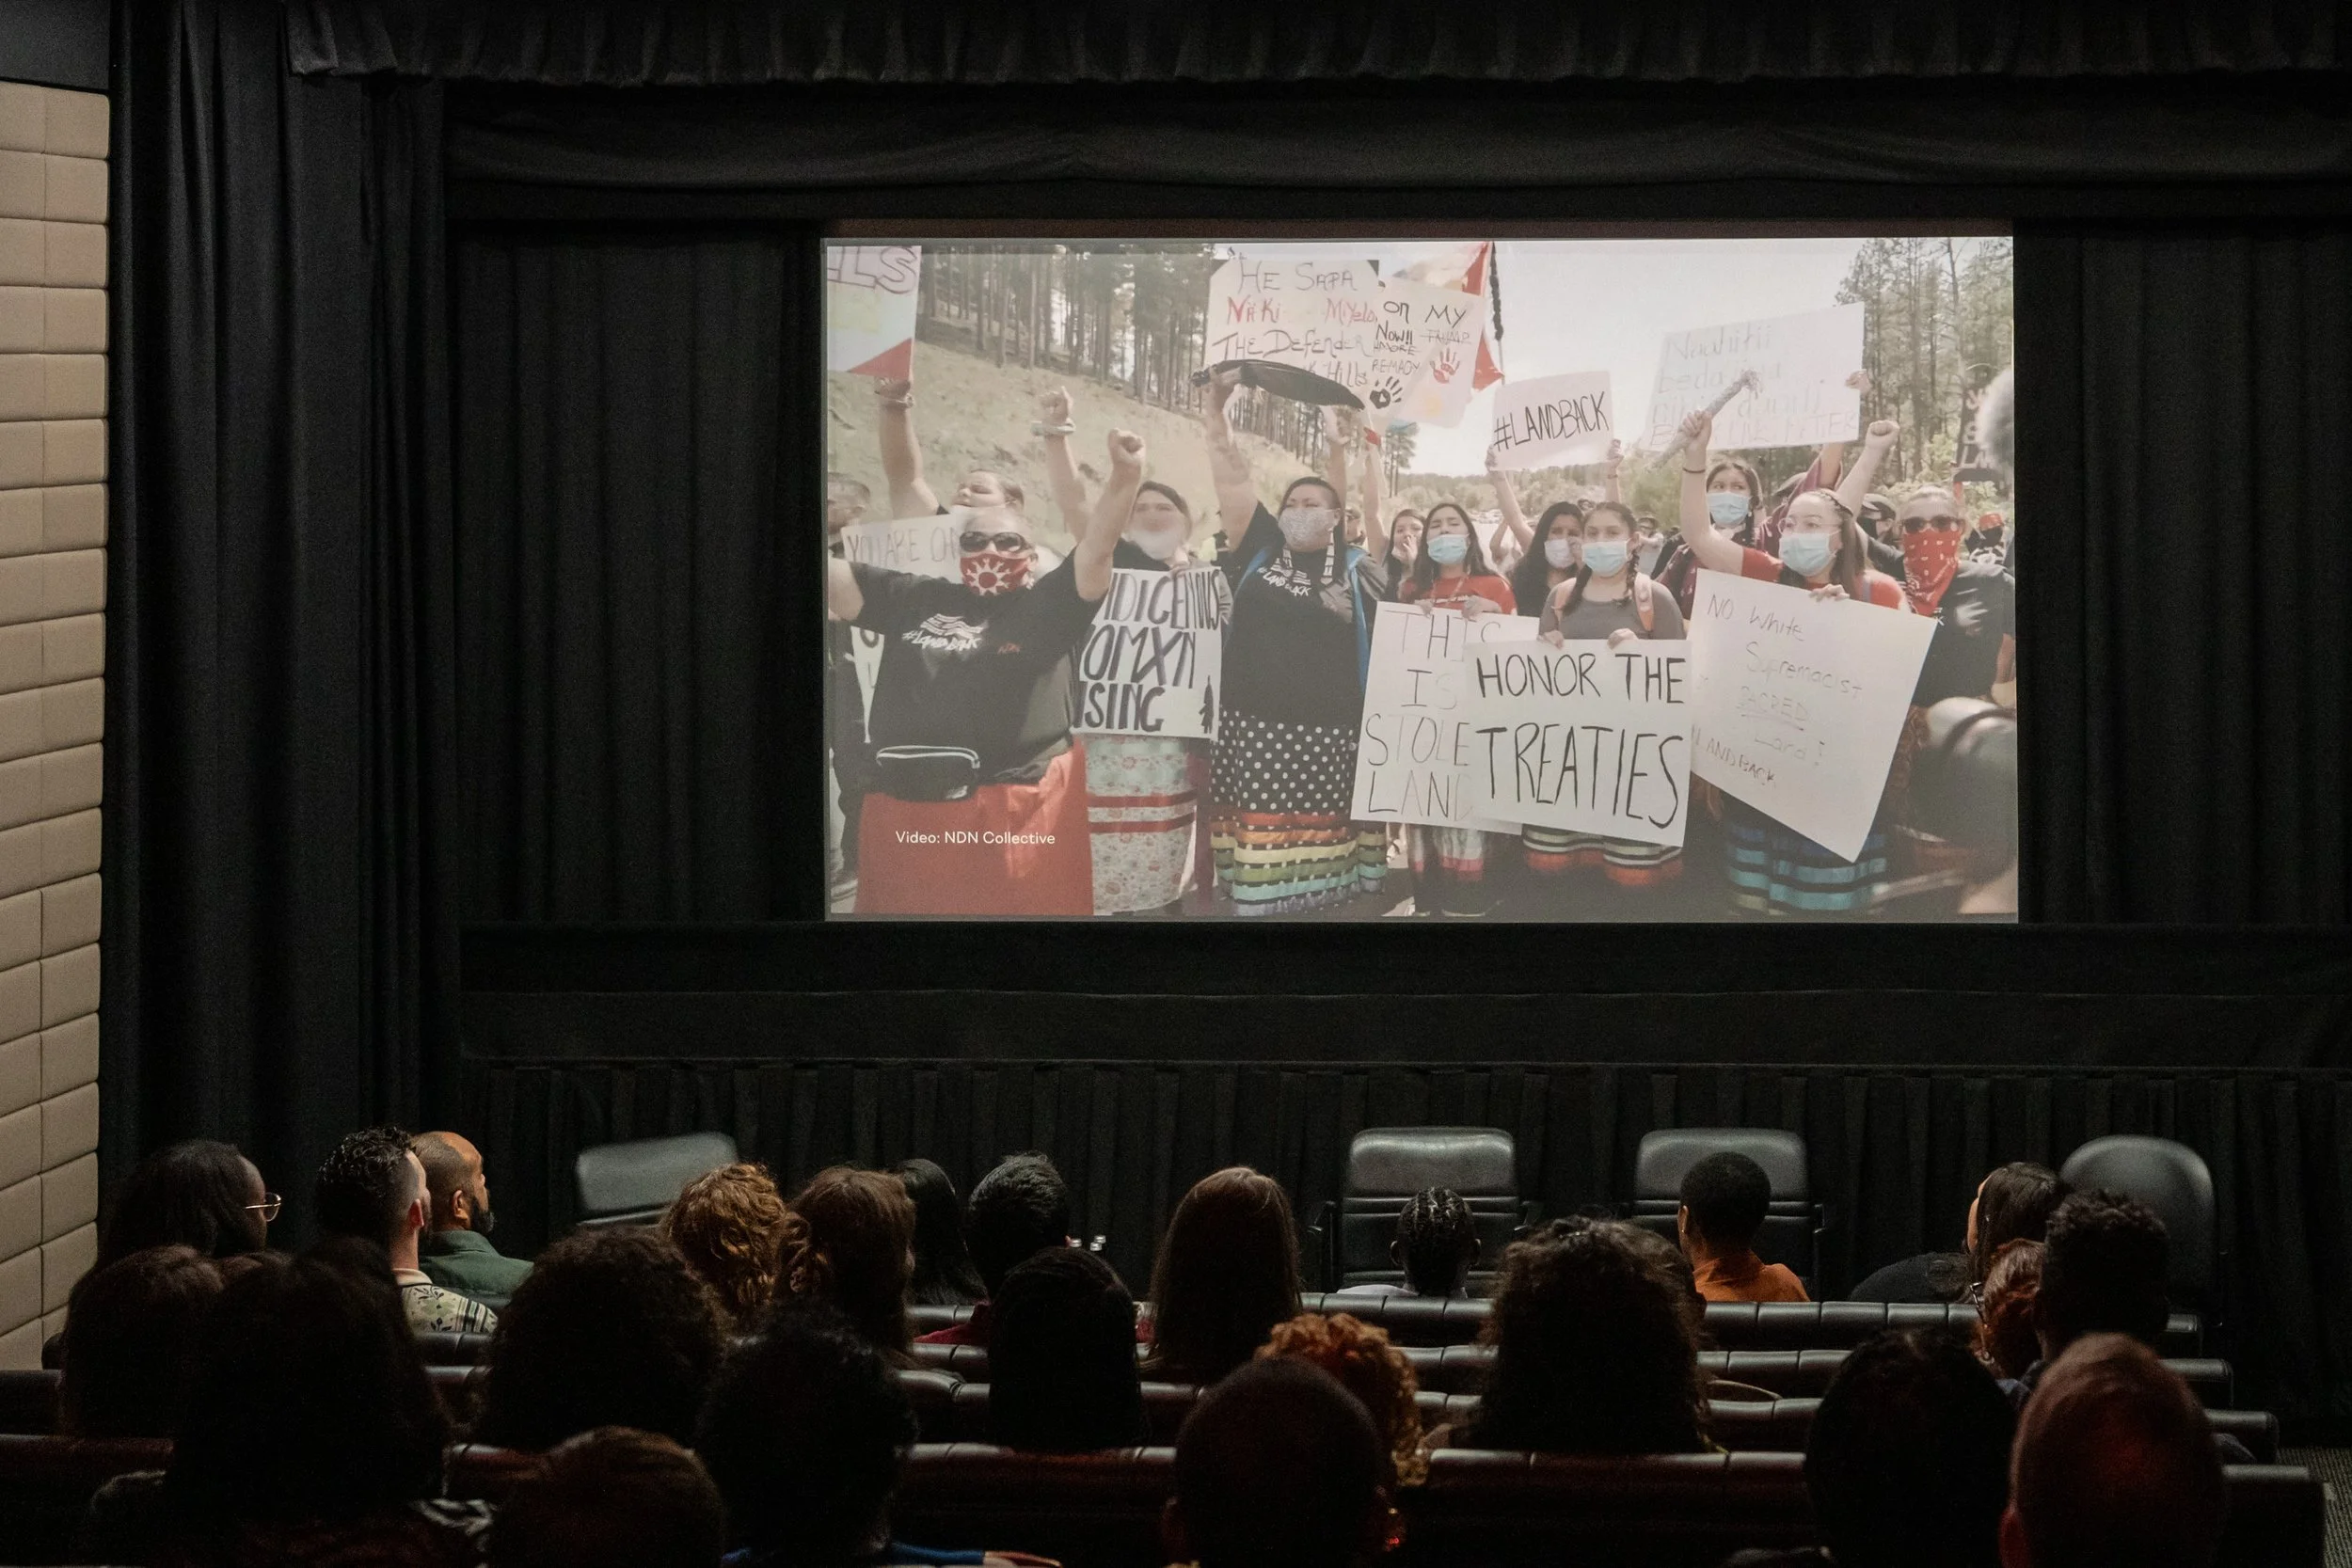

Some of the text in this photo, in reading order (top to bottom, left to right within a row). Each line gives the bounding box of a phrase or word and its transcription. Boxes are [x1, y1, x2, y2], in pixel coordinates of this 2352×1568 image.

[1494, 390, 1610, 451] #LANDBACK
[1707, 594, 1734, 621] NO
[1082, 623, 1196, 689] OMXN
[1476, 652, 1687, 705] HONOR THE
[1073, 680, 1167, 732] ISING
[1475, 721, 1685, 830] TREATIES
[896, 831, 1057, 845] Video: NDN Collective
